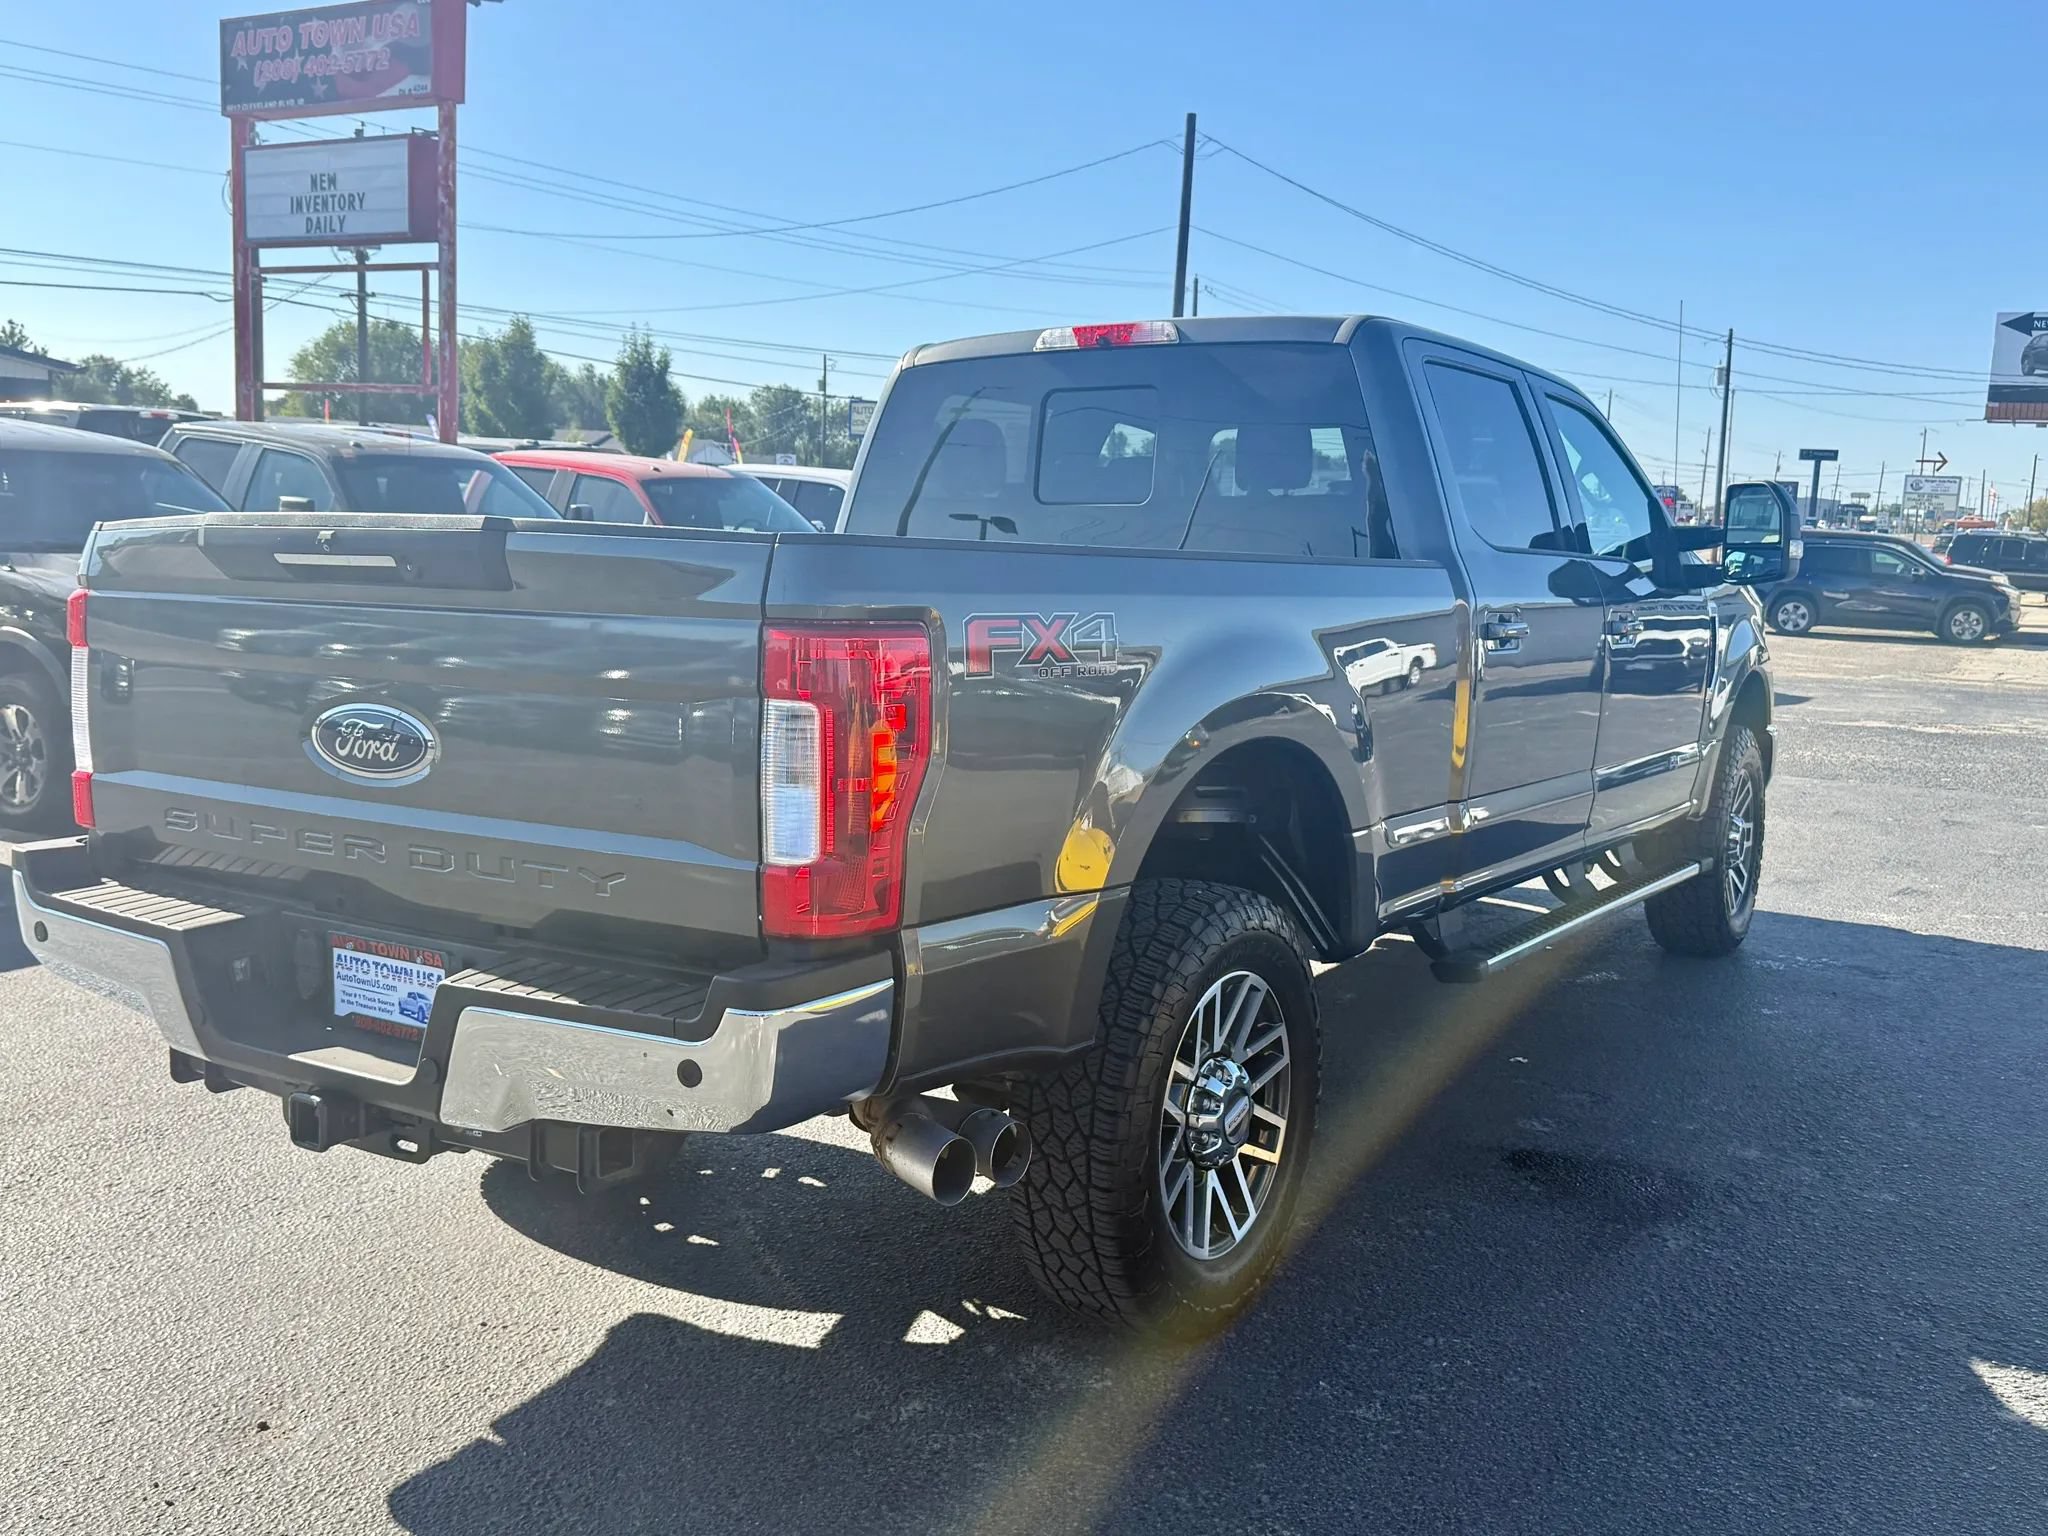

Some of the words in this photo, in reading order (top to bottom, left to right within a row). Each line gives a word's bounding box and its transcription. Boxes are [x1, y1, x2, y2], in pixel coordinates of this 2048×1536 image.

[230, 26, 293, 57] AUTO
[299, 17, 368, 48] TOWN
[373, 11, 420, 39] USA
[303, 48, 390, 77] 402-5772
[310, 172, 337, 192] NEW
[290, 192, 365, 215] INVENTORY
[305, 215, 346, 234] DAILY
[2033, 320, 2048, 328] NE
[963, 612, 1119, 680] FX4
[1039, 666, 1071, 679] OFF
[1077, 665, 1118, 677] ROAD
[336, 718, 400, 762] Ford
[163, 806, 387, 864] SUPER
[409, 843, 627, 898] DUTY
[368, 942, 410, 960] TOWN
[415, 950, 443, 966] USA
[336, 954, 371, 975] AUTO
[372, 961, 414, 985] TOWN
[416, 969, 443, 989] USA
[336, 972, 398, 993] AutoTownUS.com
[355, 1001, 377, 1011] Treasure
[377, 998, 395, 1007] Source
